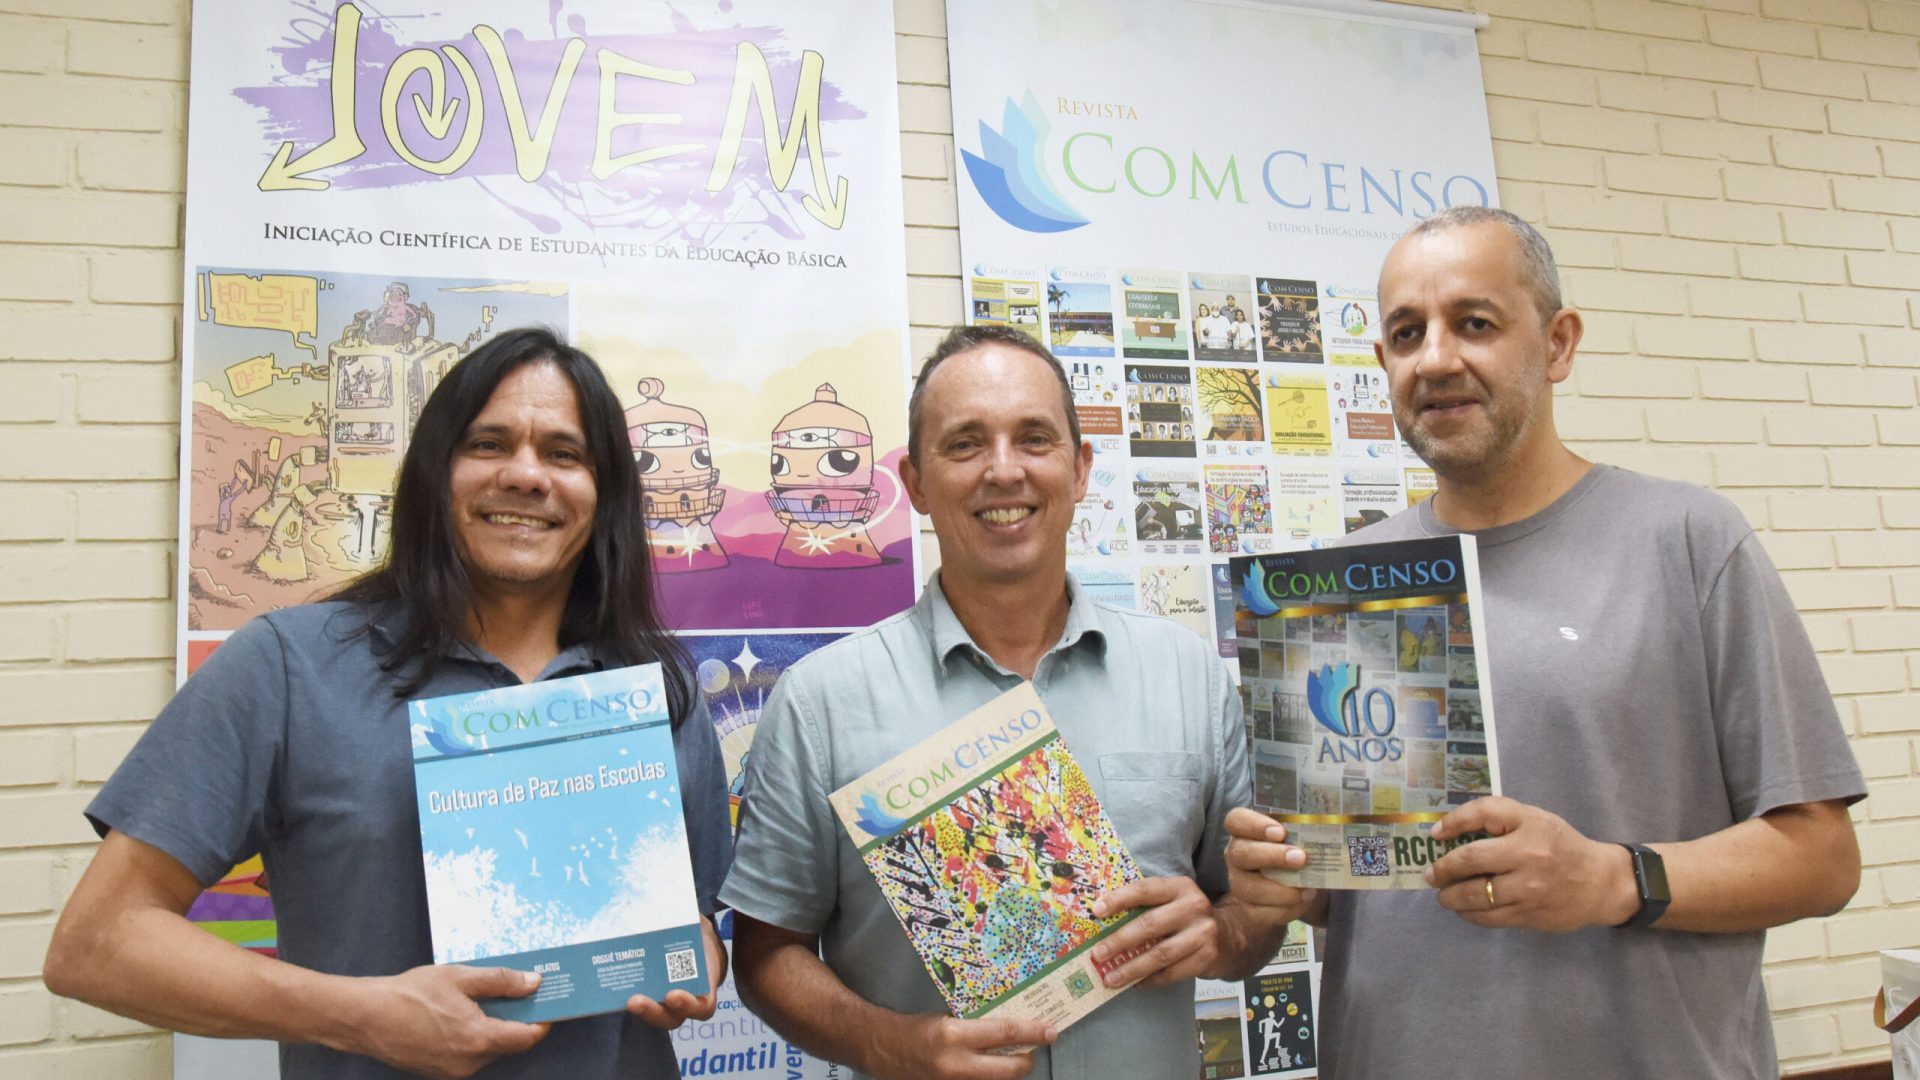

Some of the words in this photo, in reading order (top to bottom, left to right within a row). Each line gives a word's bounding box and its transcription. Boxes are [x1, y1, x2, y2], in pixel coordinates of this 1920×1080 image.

[257, 2, 848, 230] JOVEM
[1056, 95, 1139, 120] REVISTA
[263, 222, 373, 247] INICIAÇÃO
[379, 228, 491, 252] CIENTÍFICA
[497, 237, 523, 252] DE
[529, 236, 648, 259] ESTUDANTES
[653, 245, 680, 260] DA
[686, 244, 781, 268] EDUCAÇÃO
[785, 250, 848, 269] BÁSICA
[1343, 686, 1397, 738] 10
[1317, 736, 1403, 764] ANOS
[428, 789, 500, 815] Cultura
[502, 781, 526, 804] de
[528, 776, 561, 801] Paz
[563, 773, 596, 795] nas
[598, 760, 667, 788] Escolas
